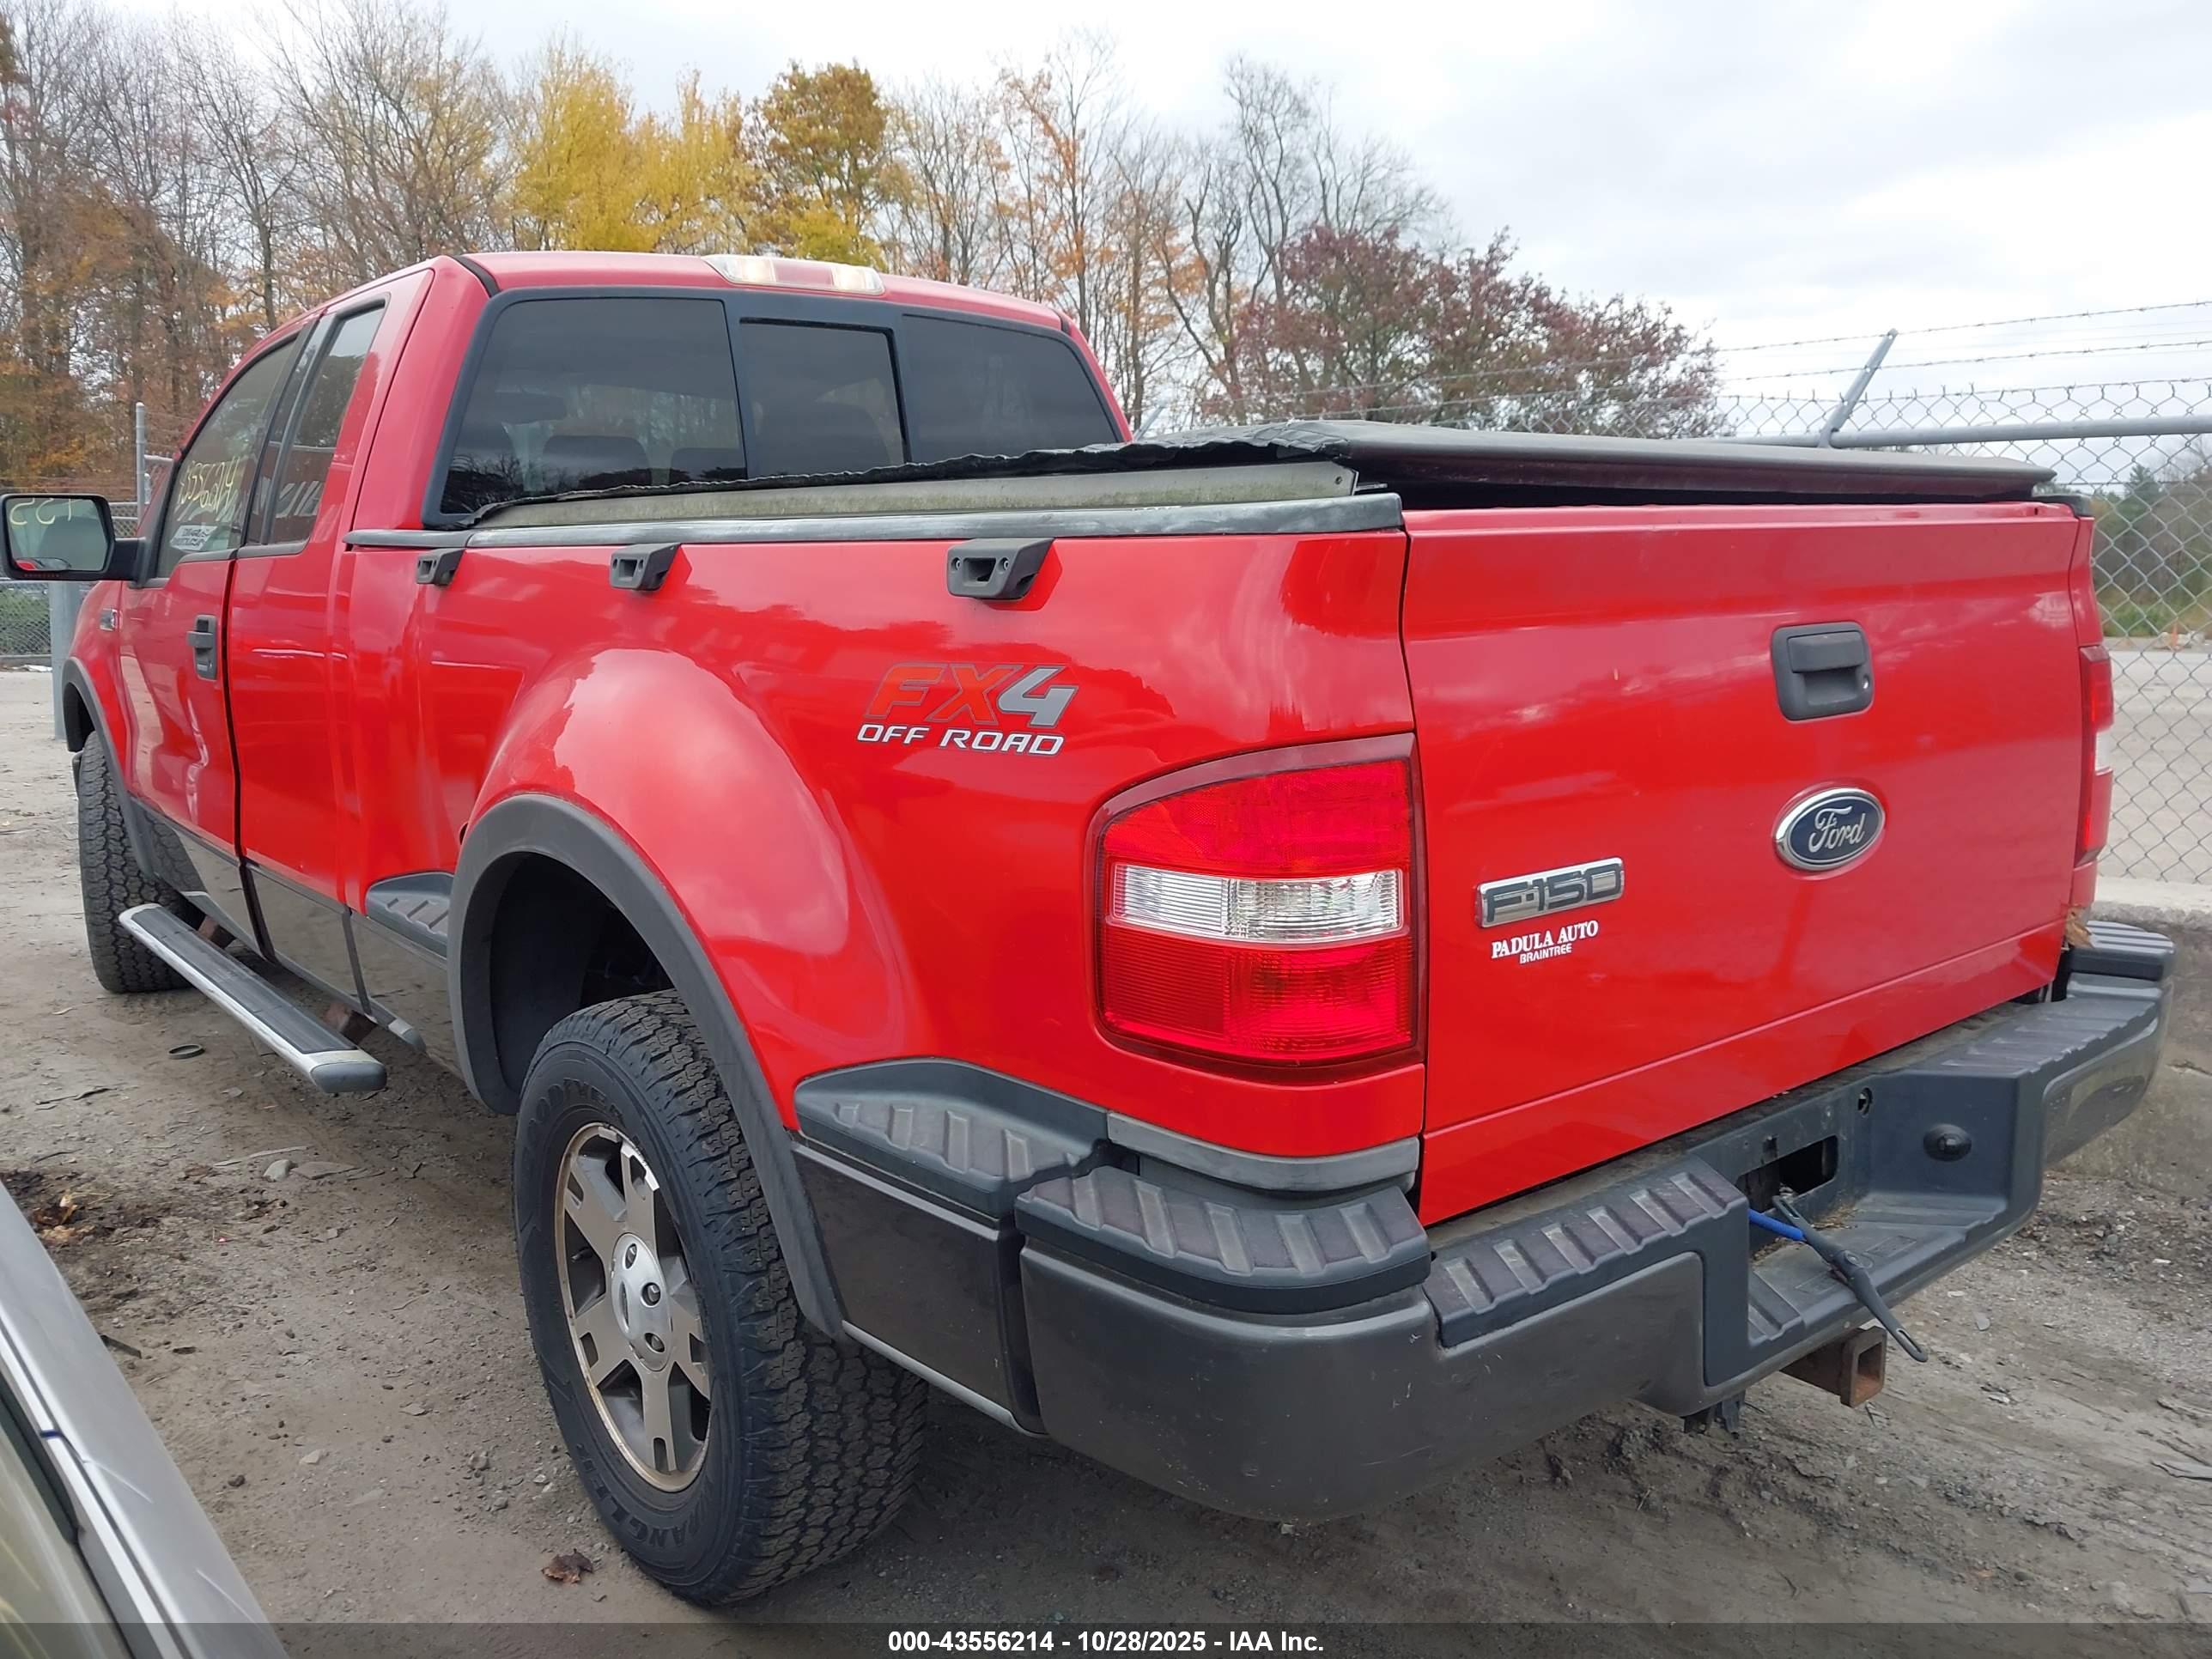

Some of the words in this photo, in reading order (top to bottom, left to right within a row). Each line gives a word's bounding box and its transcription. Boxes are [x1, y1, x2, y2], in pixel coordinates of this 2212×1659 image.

[863, 662, 1079, 728] FX4
[857, 723, 931, 744] OFF
[939, 728, 1065, 755] ROAD
[1808, 805, 1866, 853] Ford
[1486, 862, 1622, 923] F-150
[1491, 929, 1554, 959] PADULA
[1558, 920, 1599, 944] AUTO
[1519, 942, 1572, 963] BRAINTREE
